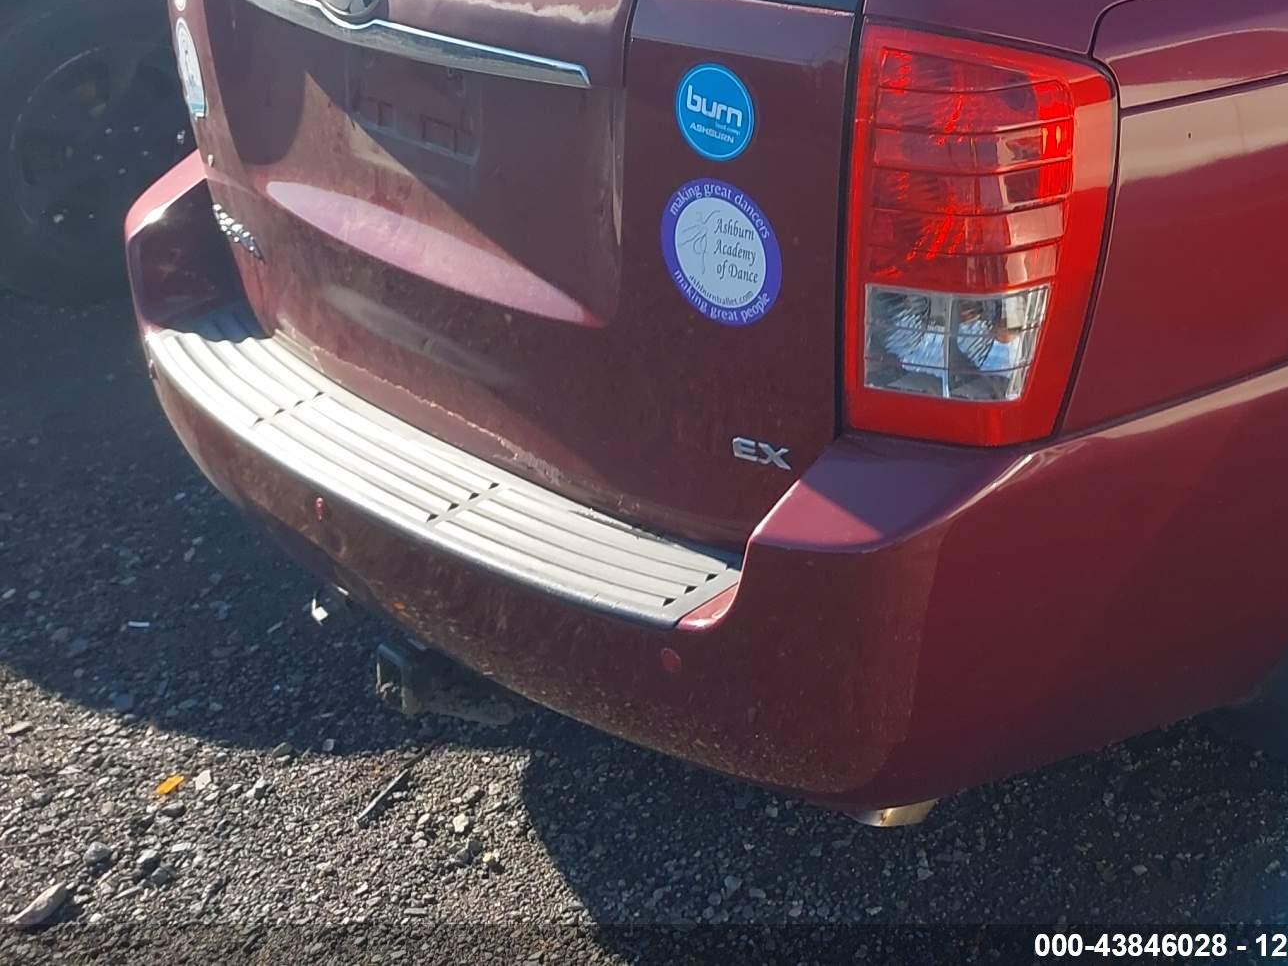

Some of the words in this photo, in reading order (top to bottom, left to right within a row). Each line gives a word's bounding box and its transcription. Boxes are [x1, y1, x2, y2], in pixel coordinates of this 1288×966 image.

[686, 84, 743, 128] burn
[690, 122, 735, 144] ASHBURN
[669, 184, 702, 216] making
[704, 183, 732, 200] great
[734, 194, 770, 239] dancers
[714, 217, 755, 241] Ashburn
[714, 239, 756, 266] Academy
[716, 260, 728, 280] of
[728, 263, 759, 284] Dance
[674, 270, 707, 313] making
[710, 306, 738, 322] great
[740, 293, 770, 323] people
[732, 436, 792, 470] EX
